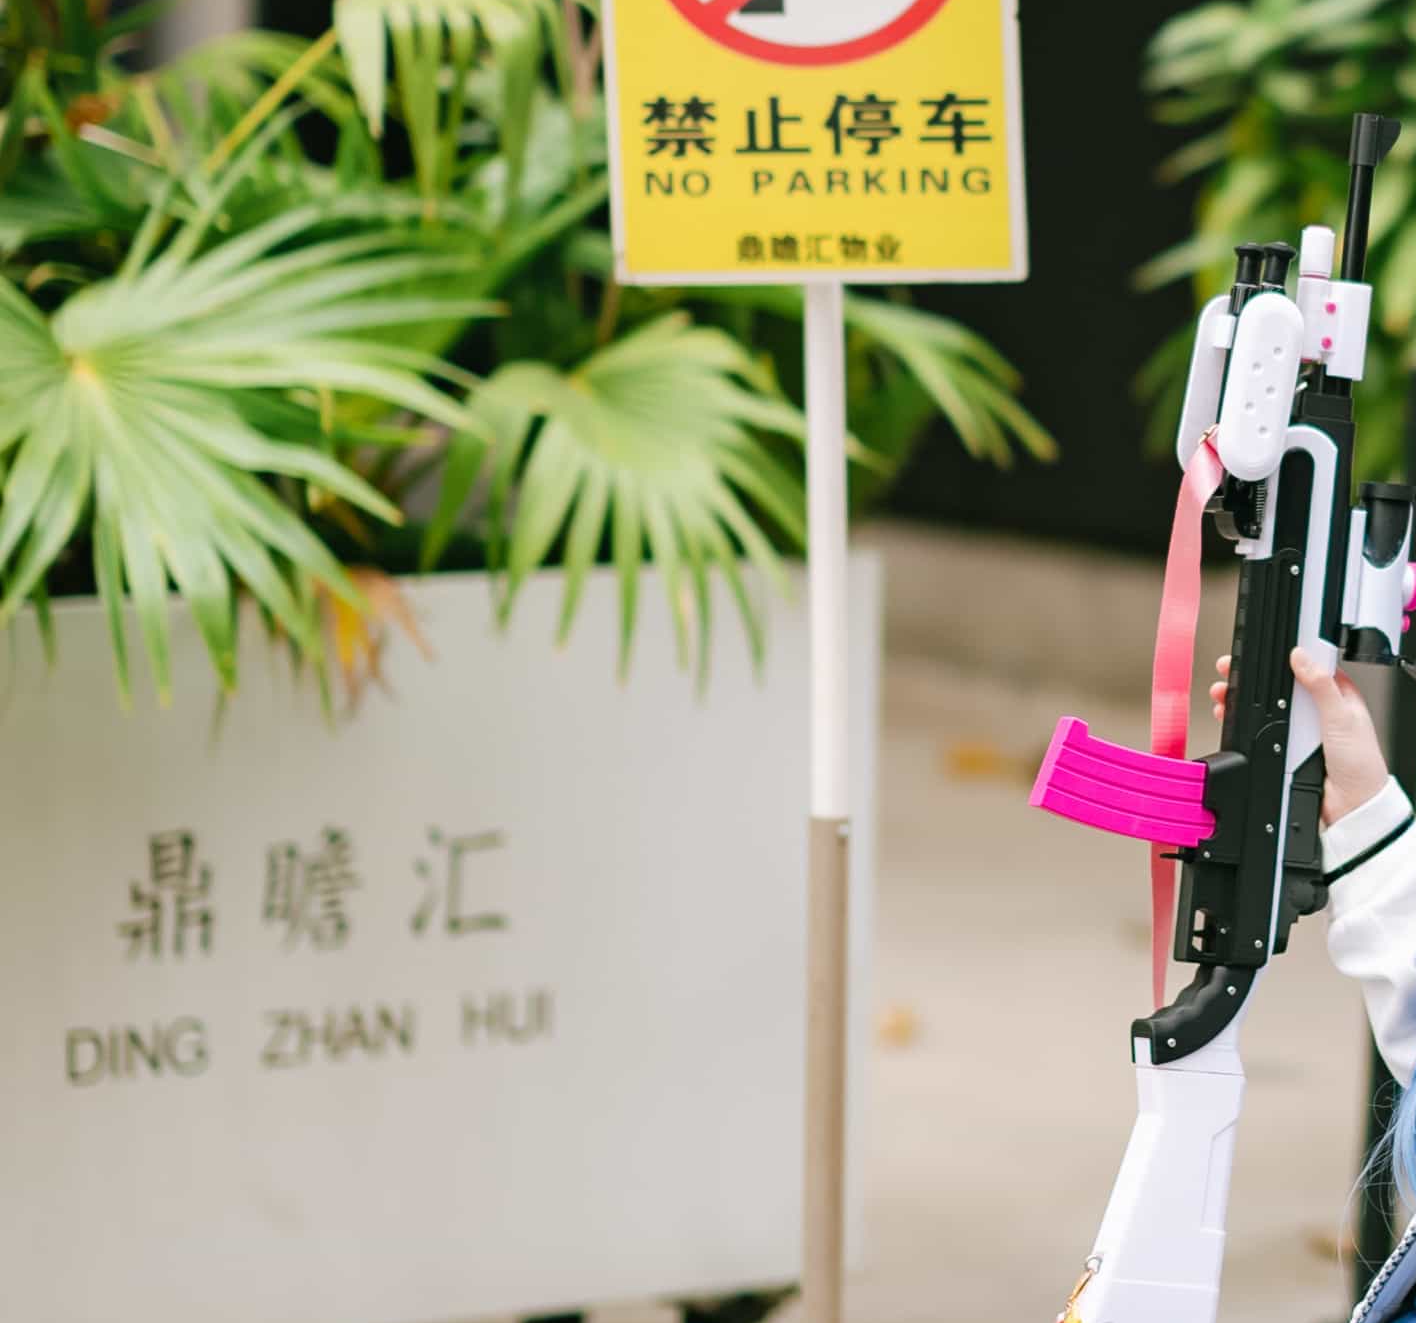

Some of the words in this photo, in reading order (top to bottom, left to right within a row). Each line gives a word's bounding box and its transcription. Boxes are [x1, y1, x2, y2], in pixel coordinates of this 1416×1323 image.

[643, 93, 993, 157] 禁止停车
[644, 169, 711, 197] NO
[752, 167, 992, 196] PARKING
[116, 823, 508, 962] 鼎瞻汇
[64, 1016, 210, 1088] DING
[260, 998, 417, 1070] ZHAN
[459, 987, 556, 1048] HUI
